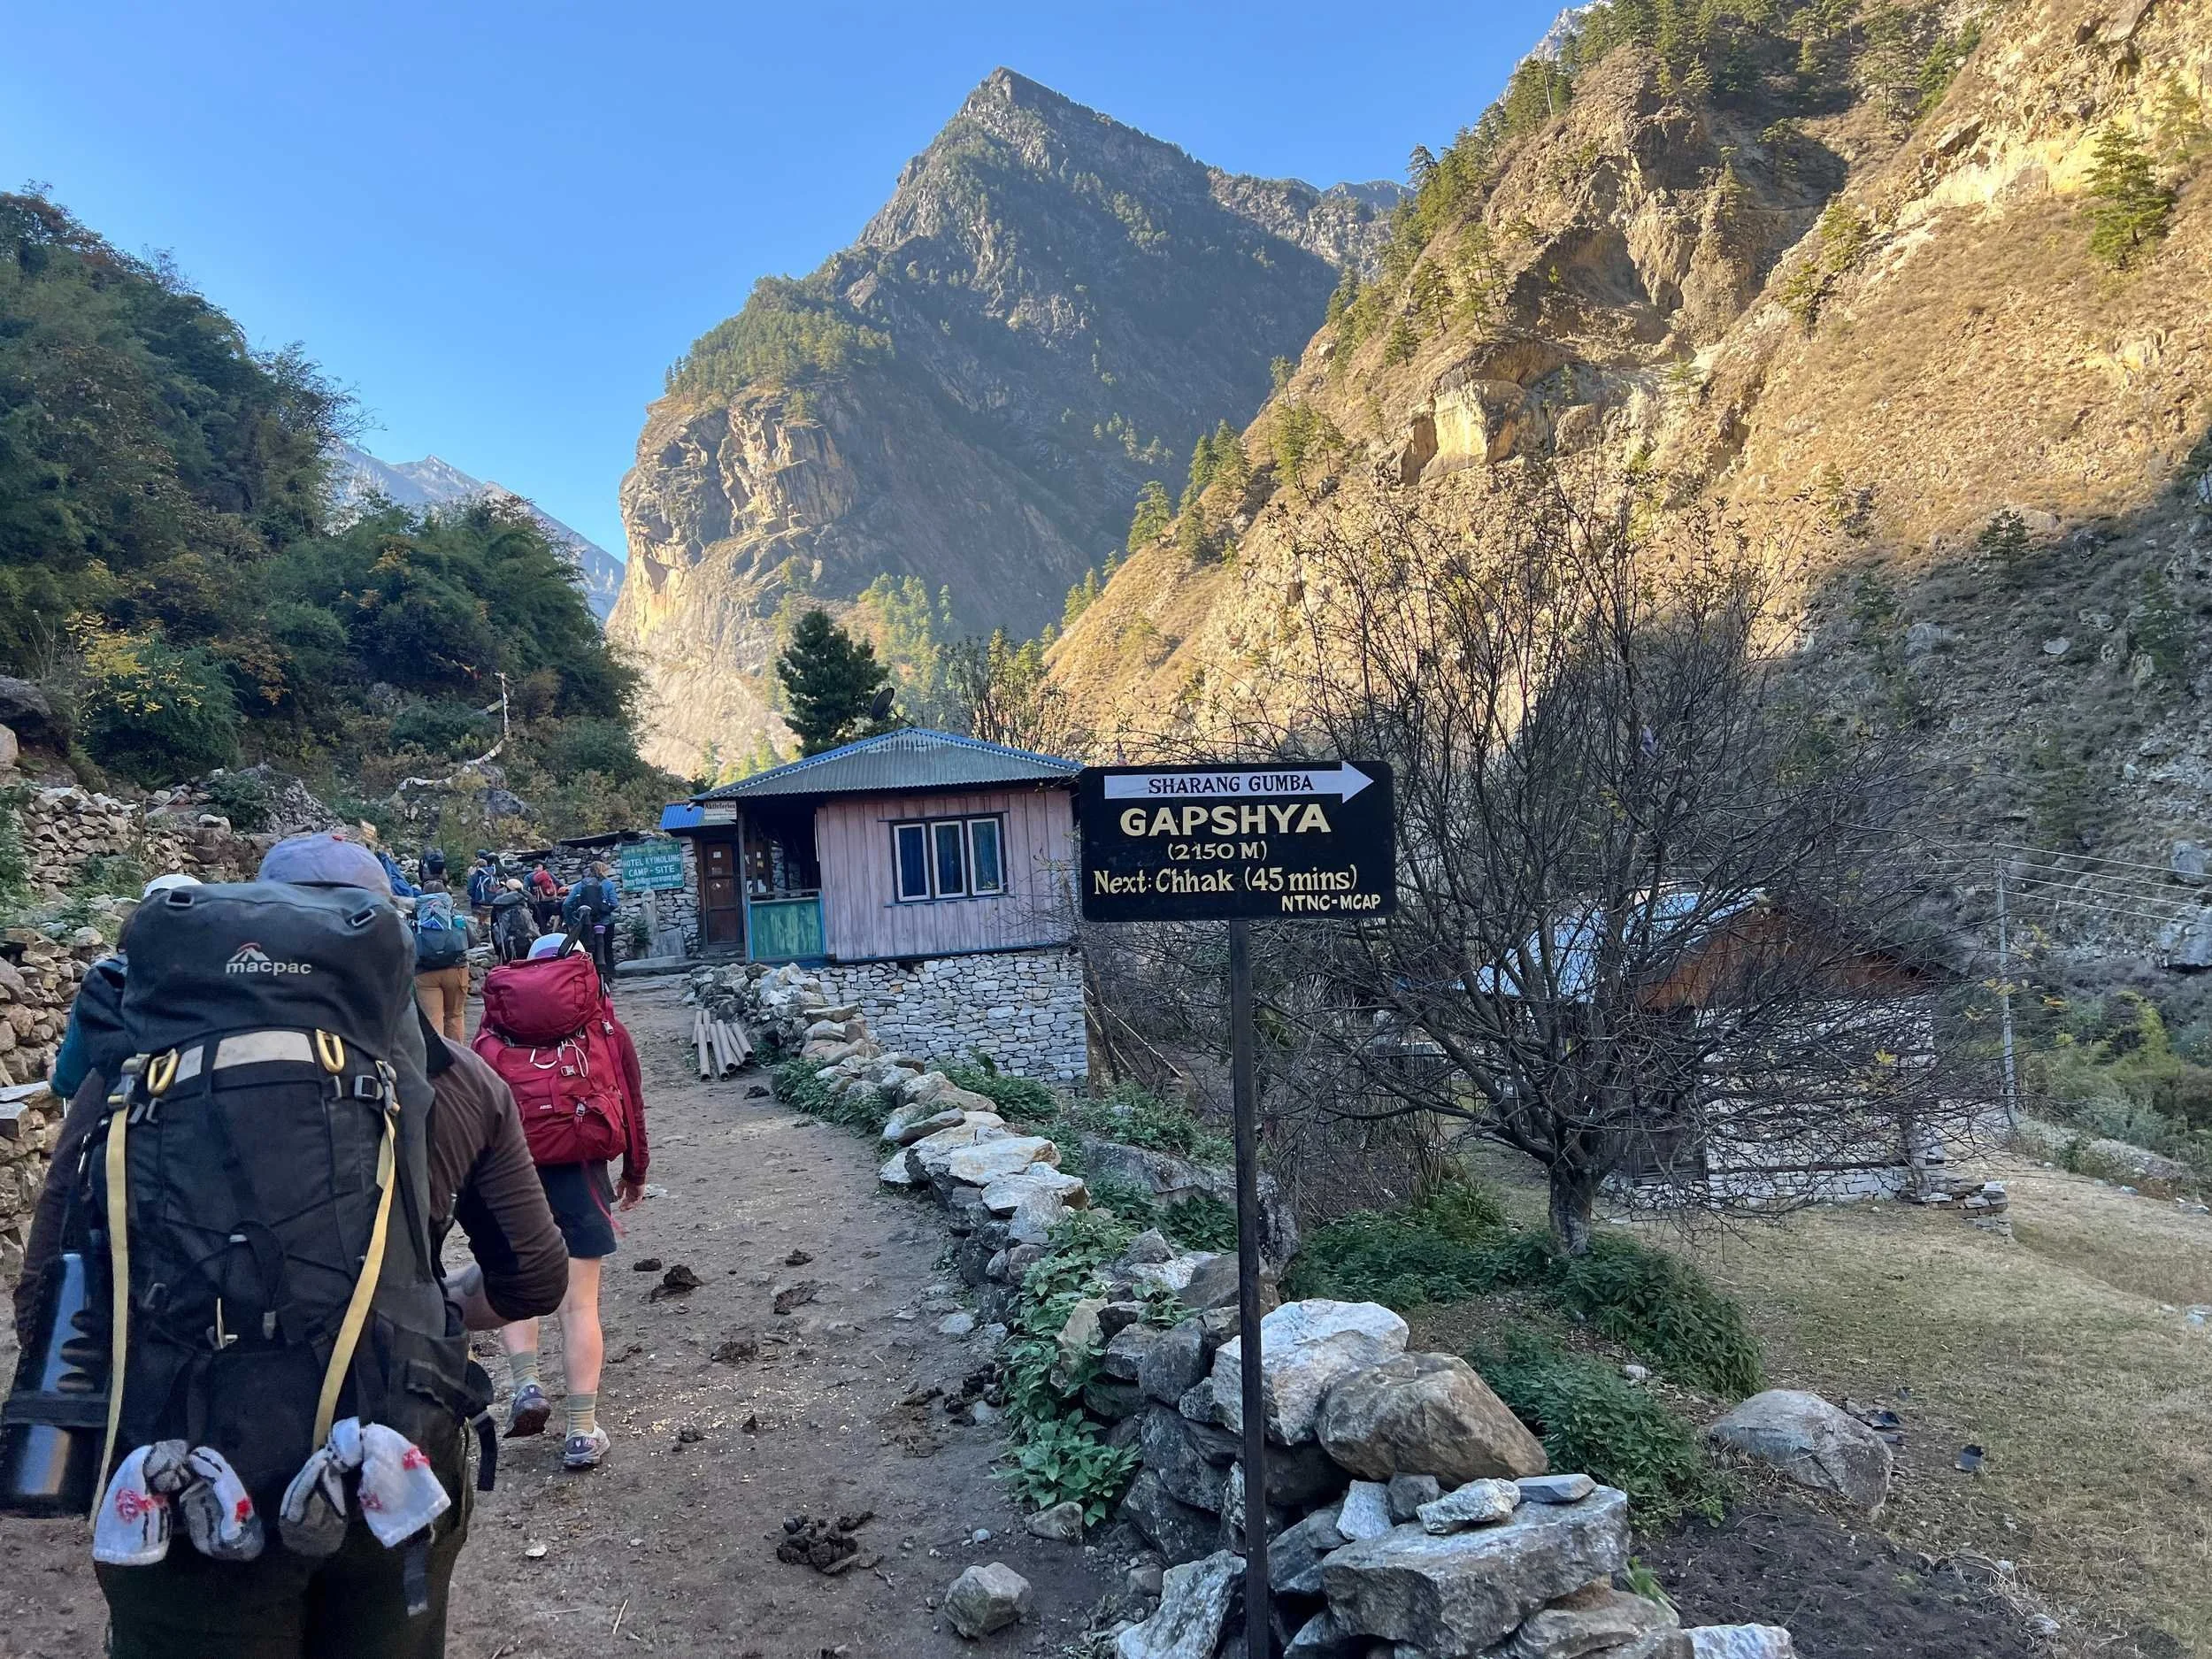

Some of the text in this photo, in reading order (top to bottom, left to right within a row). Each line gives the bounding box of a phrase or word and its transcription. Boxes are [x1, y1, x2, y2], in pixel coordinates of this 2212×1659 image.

[1148, 775, 1316, 795] SHARANG GUMBA
[1119, 803, 1332, 837] GAPSHYA
[1167, 840, 1267, 862] (2150 M)
[622, 858, 644, 868] HOTEL
[1093, 864, 1357, 895] Next: Chhak (45 mins)
[1281, 894, 1381, 913] NTNC-MCAP
[226, 961, 312, 977] macpac
